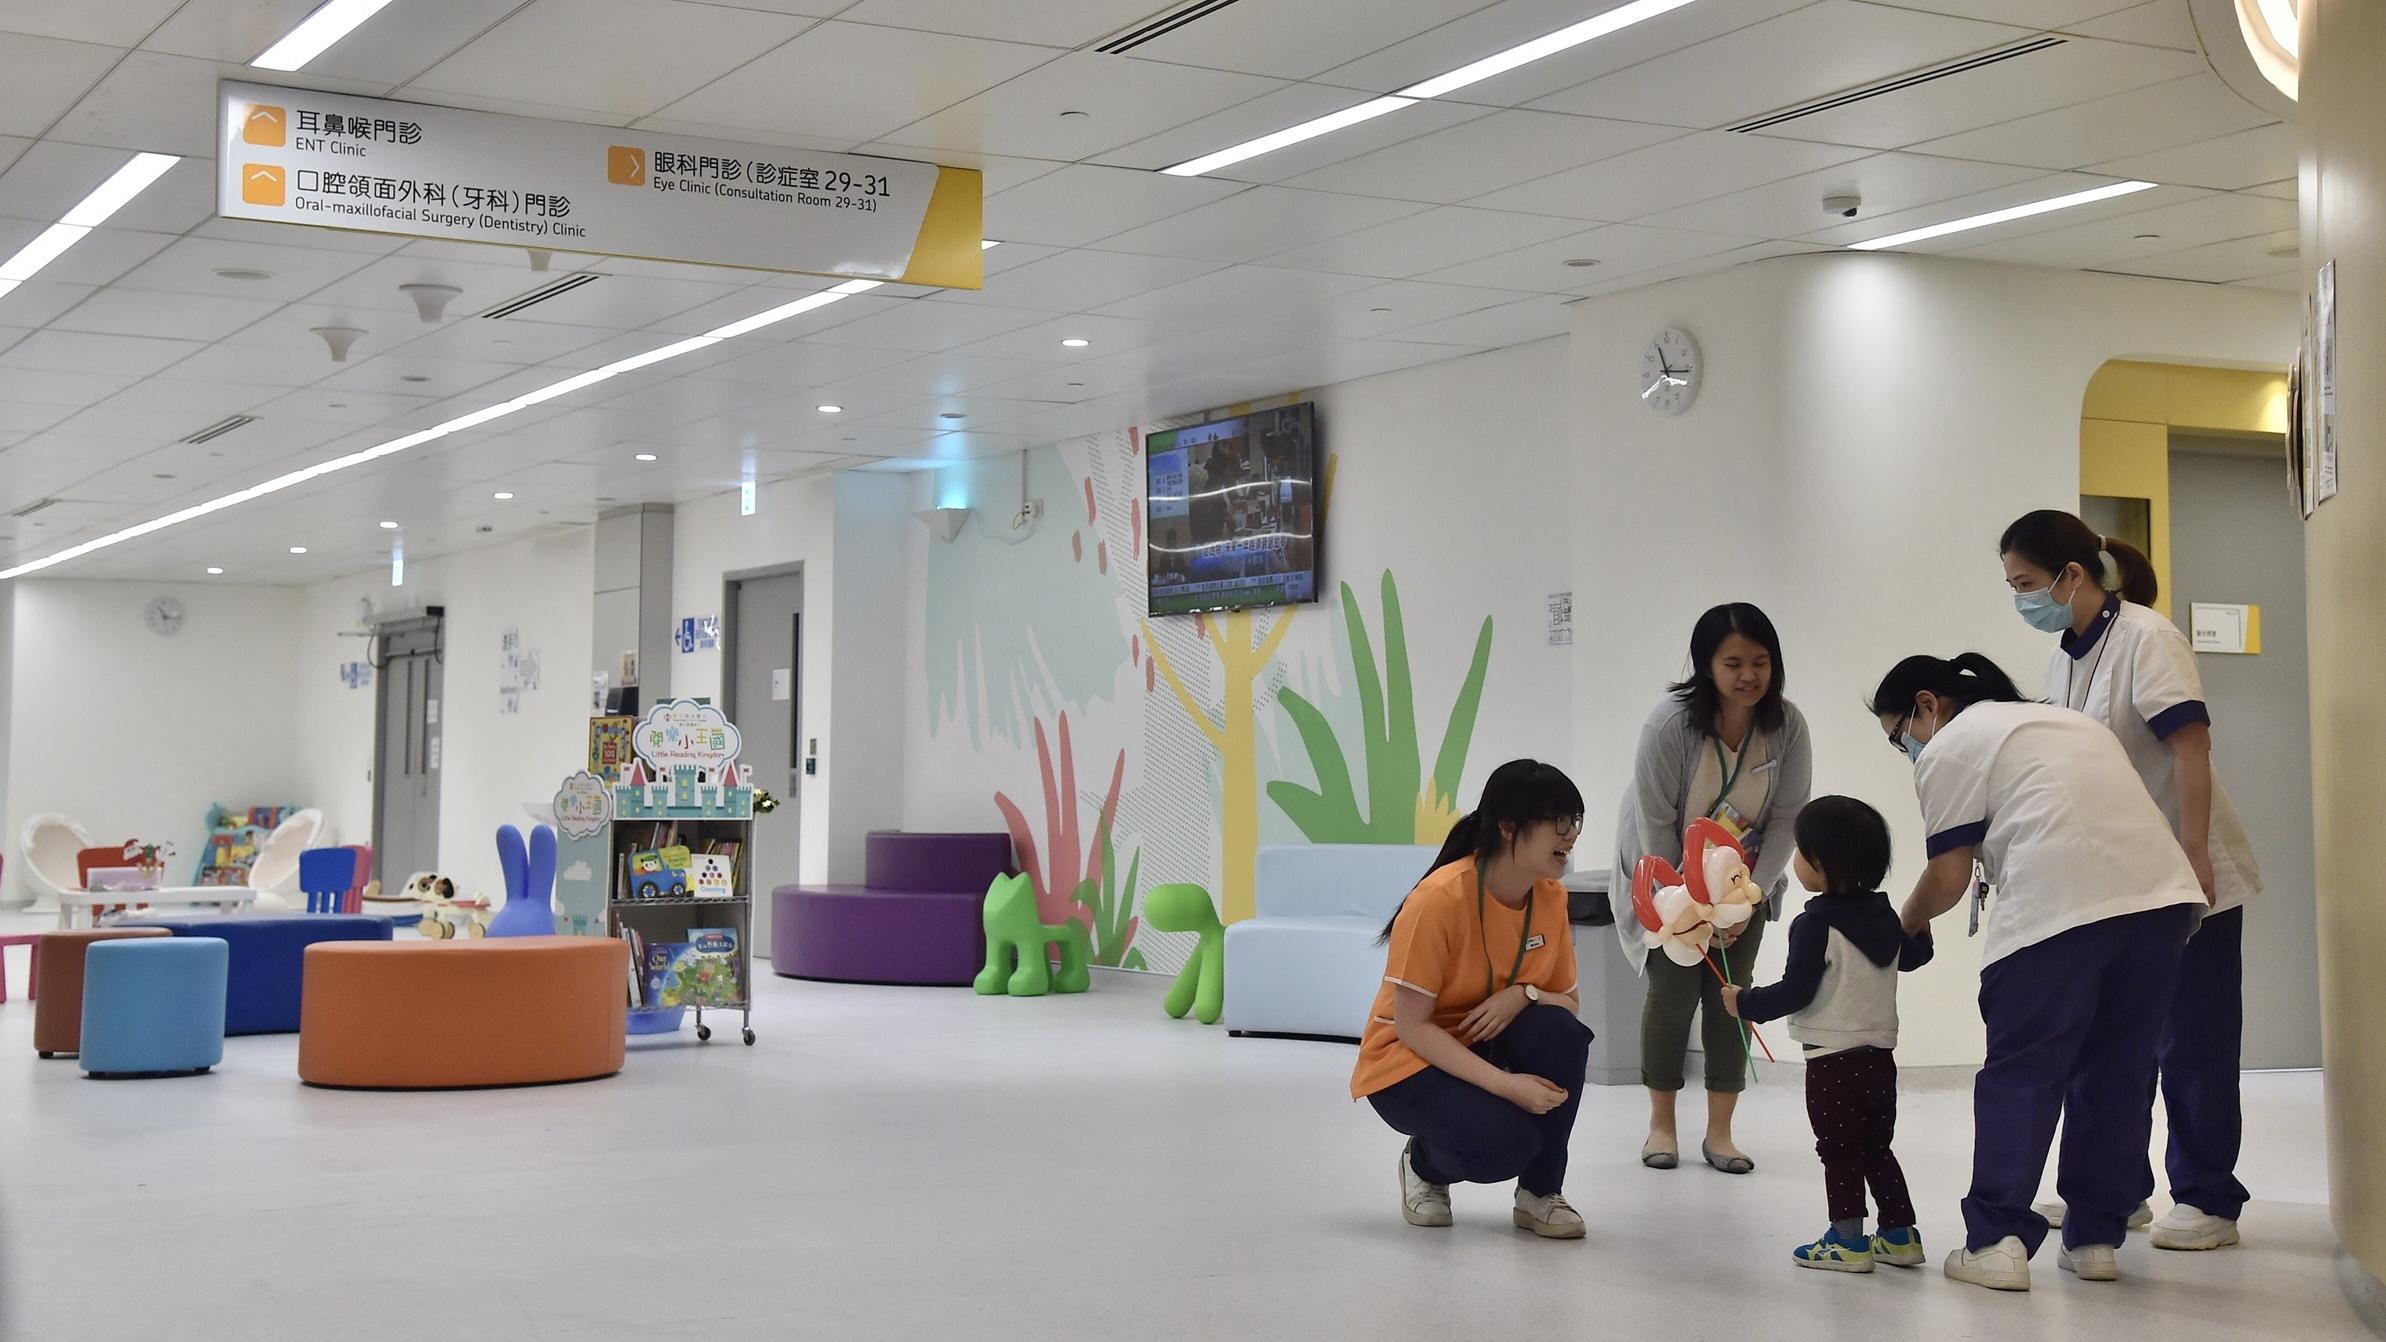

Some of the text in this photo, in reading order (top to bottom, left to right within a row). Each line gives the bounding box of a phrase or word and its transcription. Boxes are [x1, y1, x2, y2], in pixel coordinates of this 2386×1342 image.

[296, 109, 423, 145] 耳鼻喉門診
[296, 137, 367, 157] ENT Clinic
[653, 176, 877, 213] Eye Clinic (Consultation Room 29-31)
[825, 170, 890, 197] 29-31
[295, 196, 586, 238] Oral-maxillofacial Surgery (Dentistry) Clinic
[670, 751, 696, 759] Reading
[697, 751, 725, 759] Kingdom
